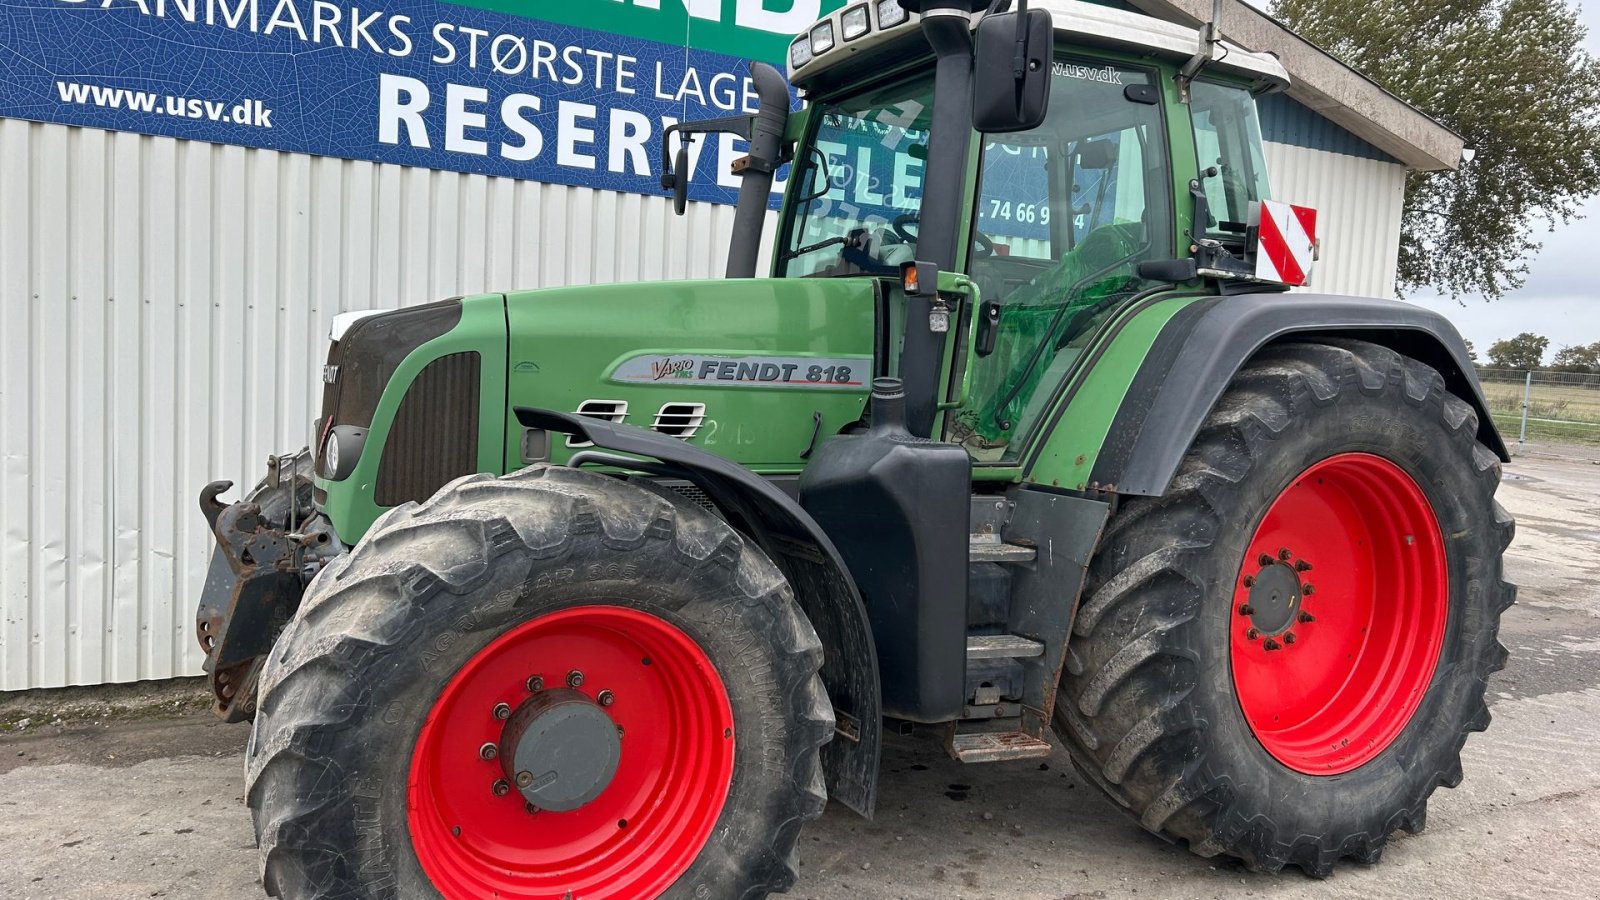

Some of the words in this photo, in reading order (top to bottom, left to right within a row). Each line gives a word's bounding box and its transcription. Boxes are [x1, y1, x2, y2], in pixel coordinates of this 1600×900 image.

[432, 22, 637, 95] STØRSTE
[655, 60, 760, 114] LAGE
[56, 80, 273, 129] www.usv.dk
[990, 199, 1011, 220] 74
[1016, 203, 1036, 224] 66
[699, 360, 798, 382] FENDT
[805, 364, 852, 383] 818
[587, 562, 638, 581] 365
